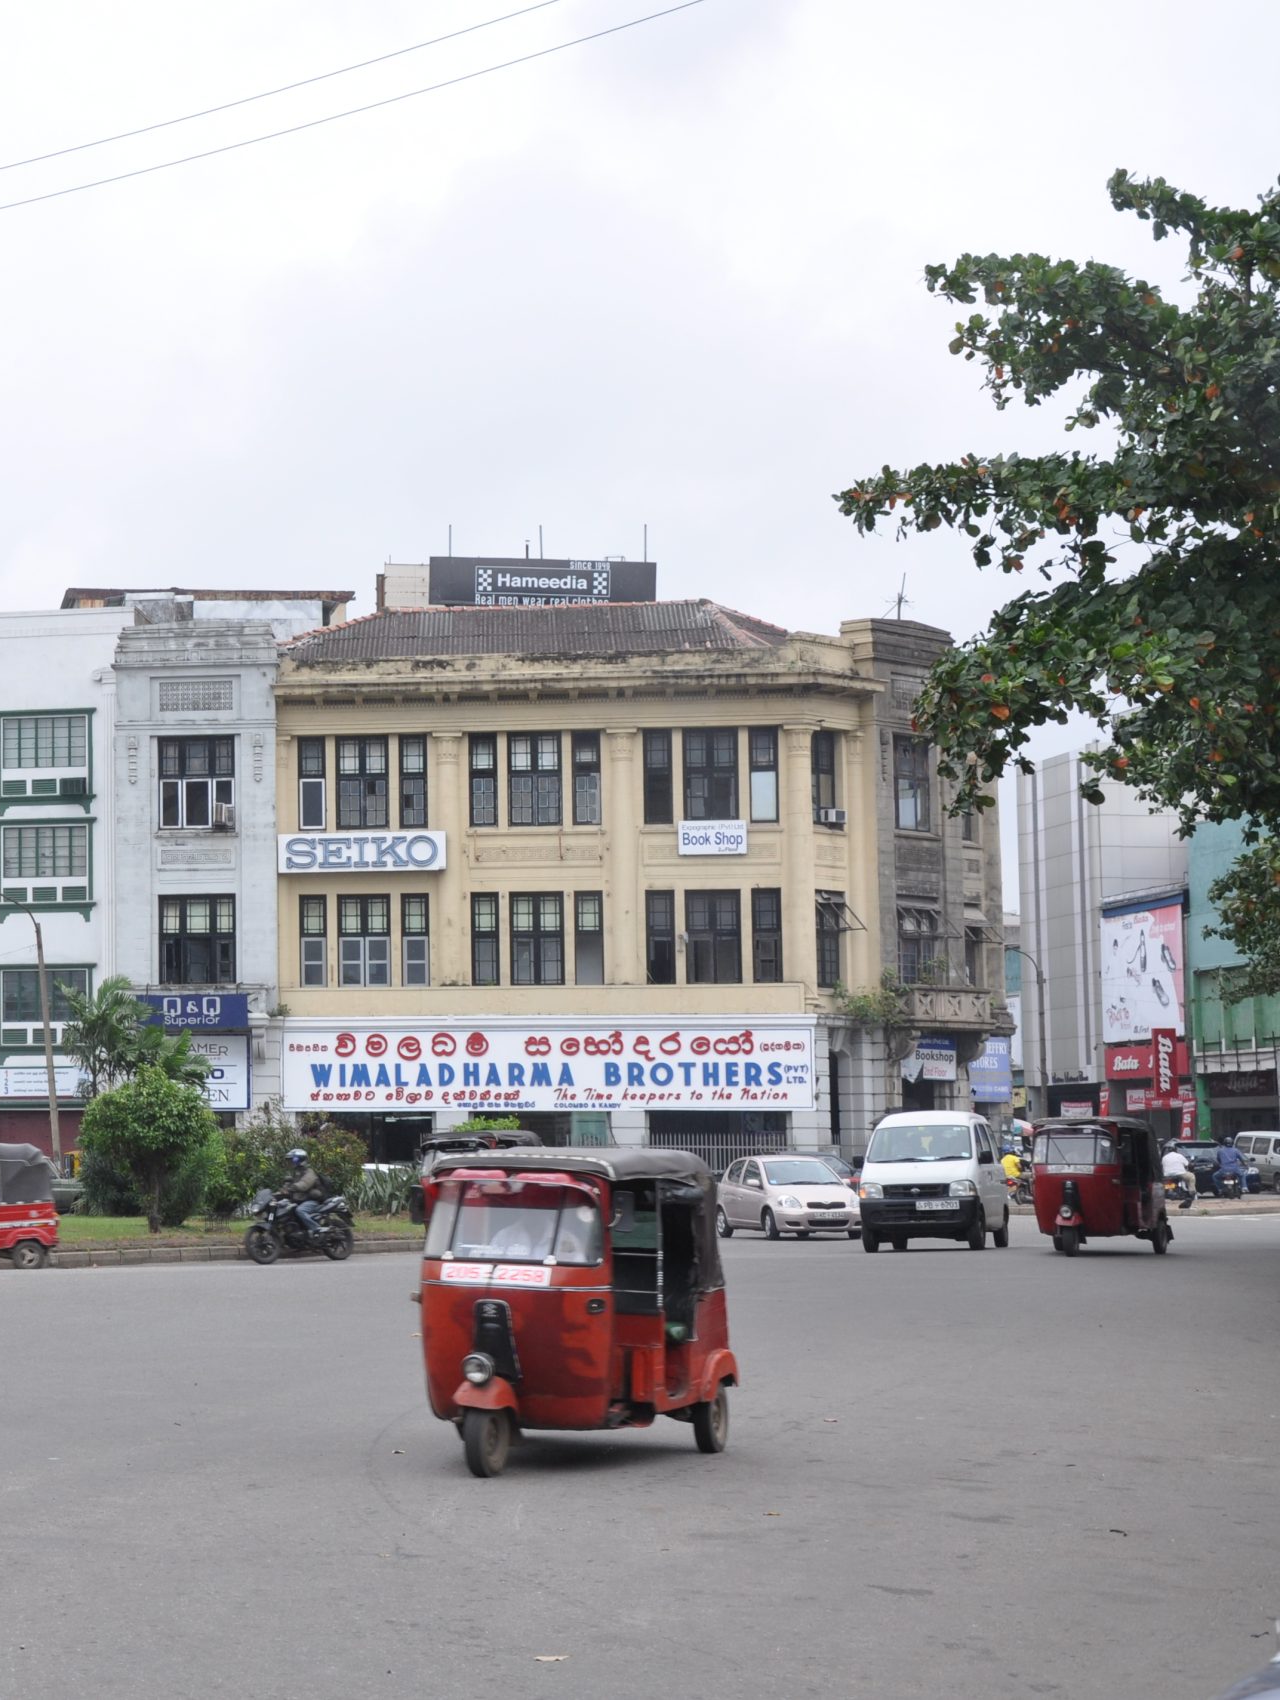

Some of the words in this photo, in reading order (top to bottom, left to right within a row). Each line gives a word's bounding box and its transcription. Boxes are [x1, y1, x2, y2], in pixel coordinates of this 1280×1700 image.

[497, 573, 588, 589] Hameedia
[475, 594, 496, 605] Real
[499, 595, 519, 606] men
[522, 597, 546, 606] wear
[683, 832, 711, 846] Book
[714, 831, 743, 848] Shop
[285, 835, 439, 869] SEIKO
[164, 1016, 220, 1026] Superior
[915, 1050, 955, 1064] Bookshop
[1112, 1055, 1140, 1071] Bata
[310, 1062, 575, 1087] WIMALADHARMA
[604, 1062, 783, 1087] BROTHERS
[784, 1064, 809, 1075] (PVT)
[786, 1076, 807, 1084] LTD.
[553, 1088, 577, 1100] The
[584, 1088, 613, 1100] Time
[622, 1088, 682, 1105] keepers
[690, 1089, 704, 1100] to
[711, 1087, 733, 1100] the
[738, 1088, 789, 1101] Nation
